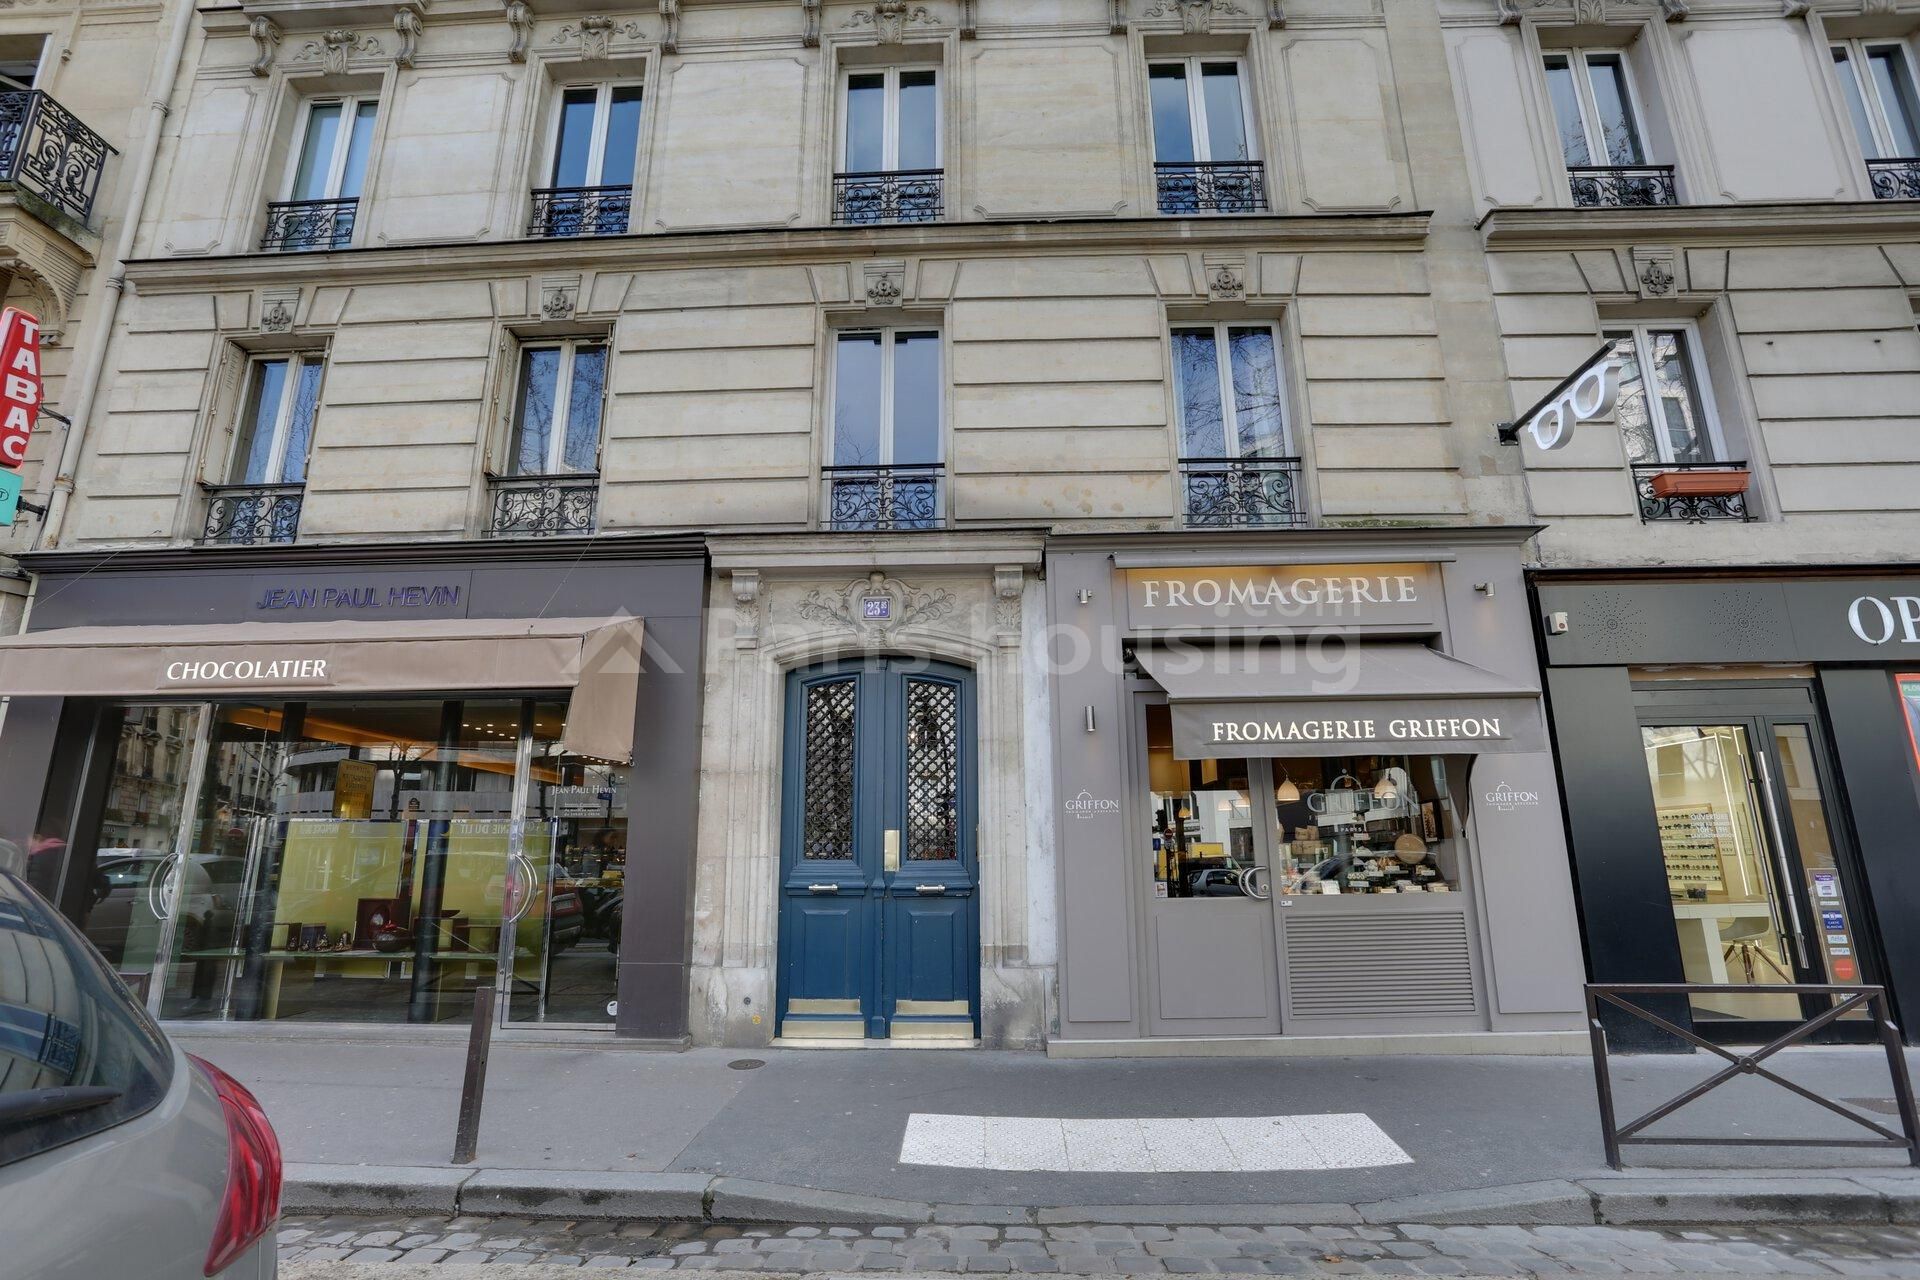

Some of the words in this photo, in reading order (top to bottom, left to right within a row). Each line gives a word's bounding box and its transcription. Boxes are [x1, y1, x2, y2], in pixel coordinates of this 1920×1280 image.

[3, 318, 39, 460] TABAC
[256, 588, 317, 609] JEAN
[323, 587, 382, 608] PAUL
[1142, 576, 1417, 608] FROMAGERIE
[167, 660, 327, 680] CHOCOLATIER
[1212, 720, 1376, 741] FROMAGERIE
[1389, 718, 1500, 739] GRIFFON
[1065, 799, 1119, 810] GRIFFON
[1485, 791, 1539, 802] GRIFFON
